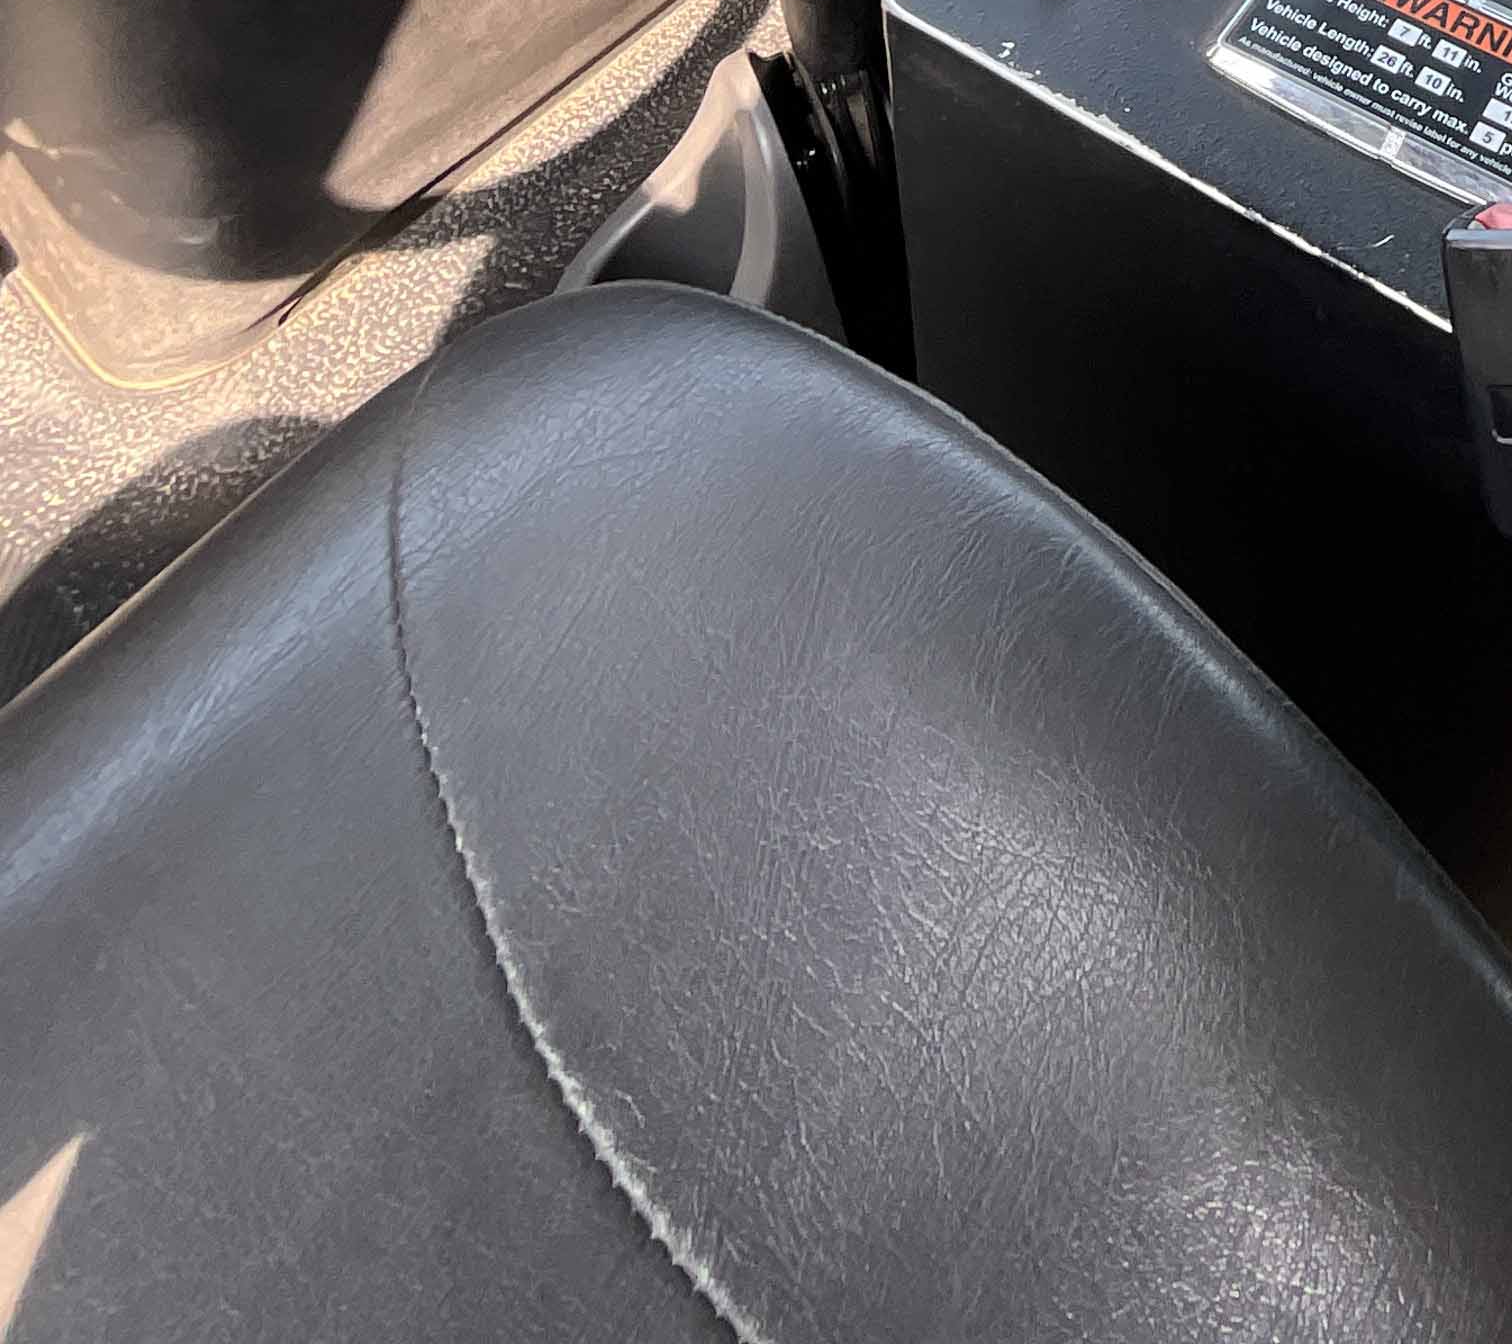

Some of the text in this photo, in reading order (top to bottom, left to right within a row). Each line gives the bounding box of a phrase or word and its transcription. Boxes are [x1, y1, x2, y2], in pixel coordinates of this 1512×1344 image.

[1251, 18, 1301, 52] Vehicle
[1303, 44, 1373, 85] designed
[1372, 78, 1390, 94] to
[1391, 90, 1432, 116] carry
[1432, 109, 1469, 134] max.
[1482, 131, 1495, 144] 5
[1318, 22, 1375, 58] Length:
[1377, 51, 1398, 67] 26
[1399, 60, 1414, 79] ft.
[1424, 73, 1442, 90] 10
[1446, 84, 1464, 102] in.
[1402, 25, 1412, 36] 7
[1418, 32, 1432, 49] ft.
[1442, 46, 1459, 58] 11
[1464, 55, 1482, 73] in.
[1238, 36, 1252, 47] As
[1312, 72, 1344, 92] vehicle
[1343, 88, 1372, 106] owner
[1371, 102, 1396, 118] must
[1395, 113, 1423, 131] revise
[1423, 126, 1447, 142] label
[1447, 137, 1461, 149] for
[1460, 146, 1479, 160] any
[1480, 154, 1512, 175] vehicle
